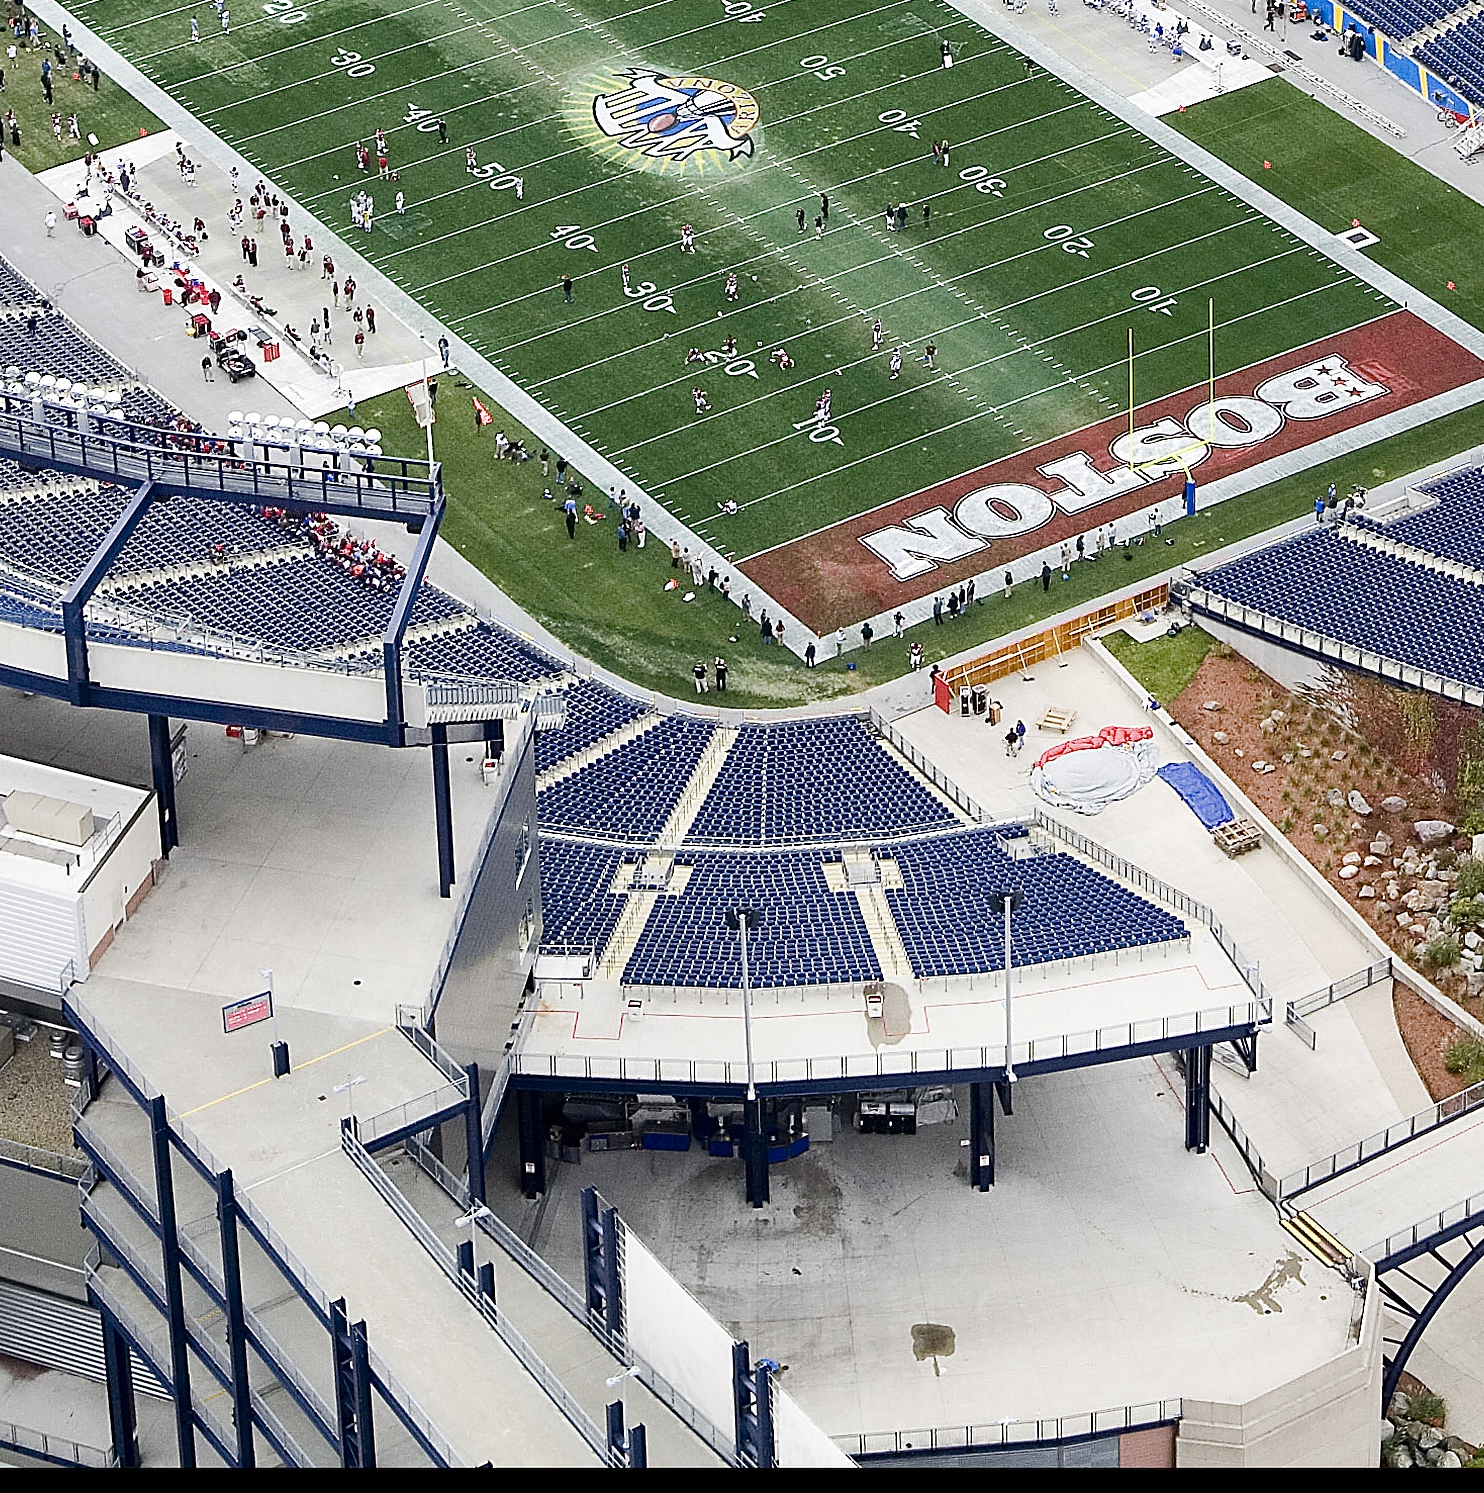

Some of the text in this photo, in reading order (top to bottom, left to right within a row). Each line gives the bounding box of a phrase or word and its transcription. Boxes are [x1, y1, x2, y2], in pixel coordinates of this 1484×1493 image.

[725, 1, 766, 23] 40
[331, 52, 375, 78] 30
[800, 56, 846, 81] 50
[664, 77, 757, 137] ARIZONA
[403, 109, 441, 132] 40
[878, 109, 921, 132] 40
[467, 162, 520, 191] 50
[959, 166, 1006, 194] 30
[550, 226, 594, 250] 40
[1044, 225, 1094, 254] 20
[624, 280, 672, 311] 30
[1132, 286, 1177, 312] 10
[792, 418, 840, 444] 10
[858, 352, 1393, 583] BOSTON
